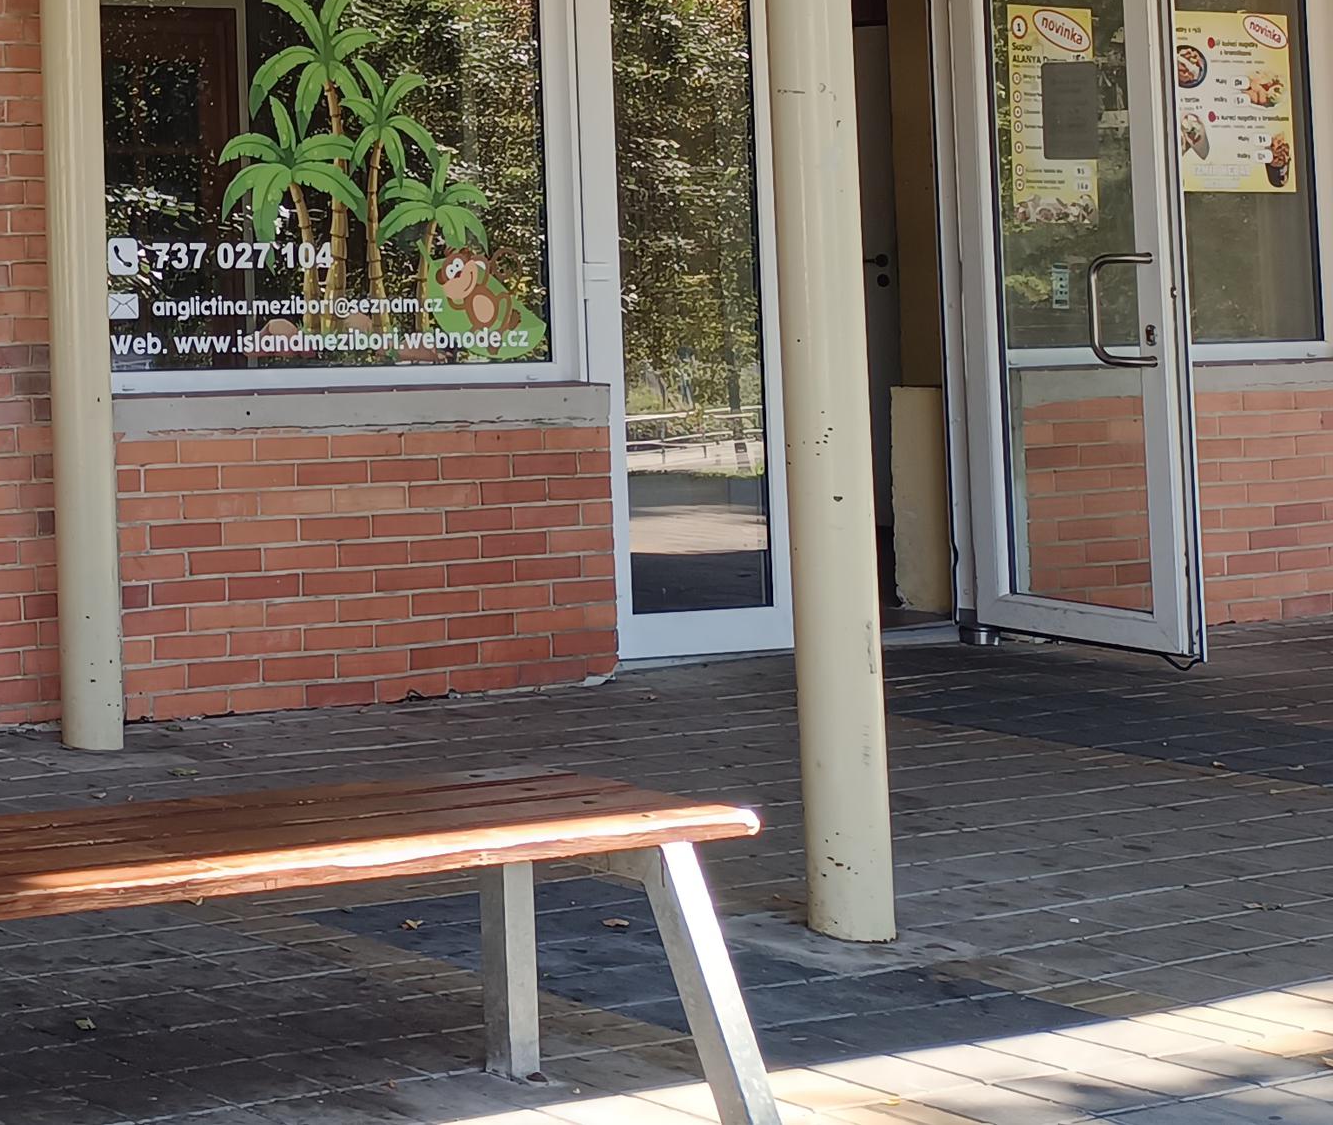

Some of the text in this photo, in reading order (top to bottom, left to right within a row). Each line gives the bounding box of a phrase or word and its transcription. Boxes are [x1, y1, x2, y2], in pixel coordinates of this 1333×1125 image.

[1041, 16, 1083, 45] novinka
[1249, 21, 1282, 43] novinka
[152, 242, 333, 270] 737 027 104
[151, 295, 443, 321] anglictina.mezibori@seznam.cz
[110, 328, 529, 355] Web. www.islandmezibori.webnode.cz
